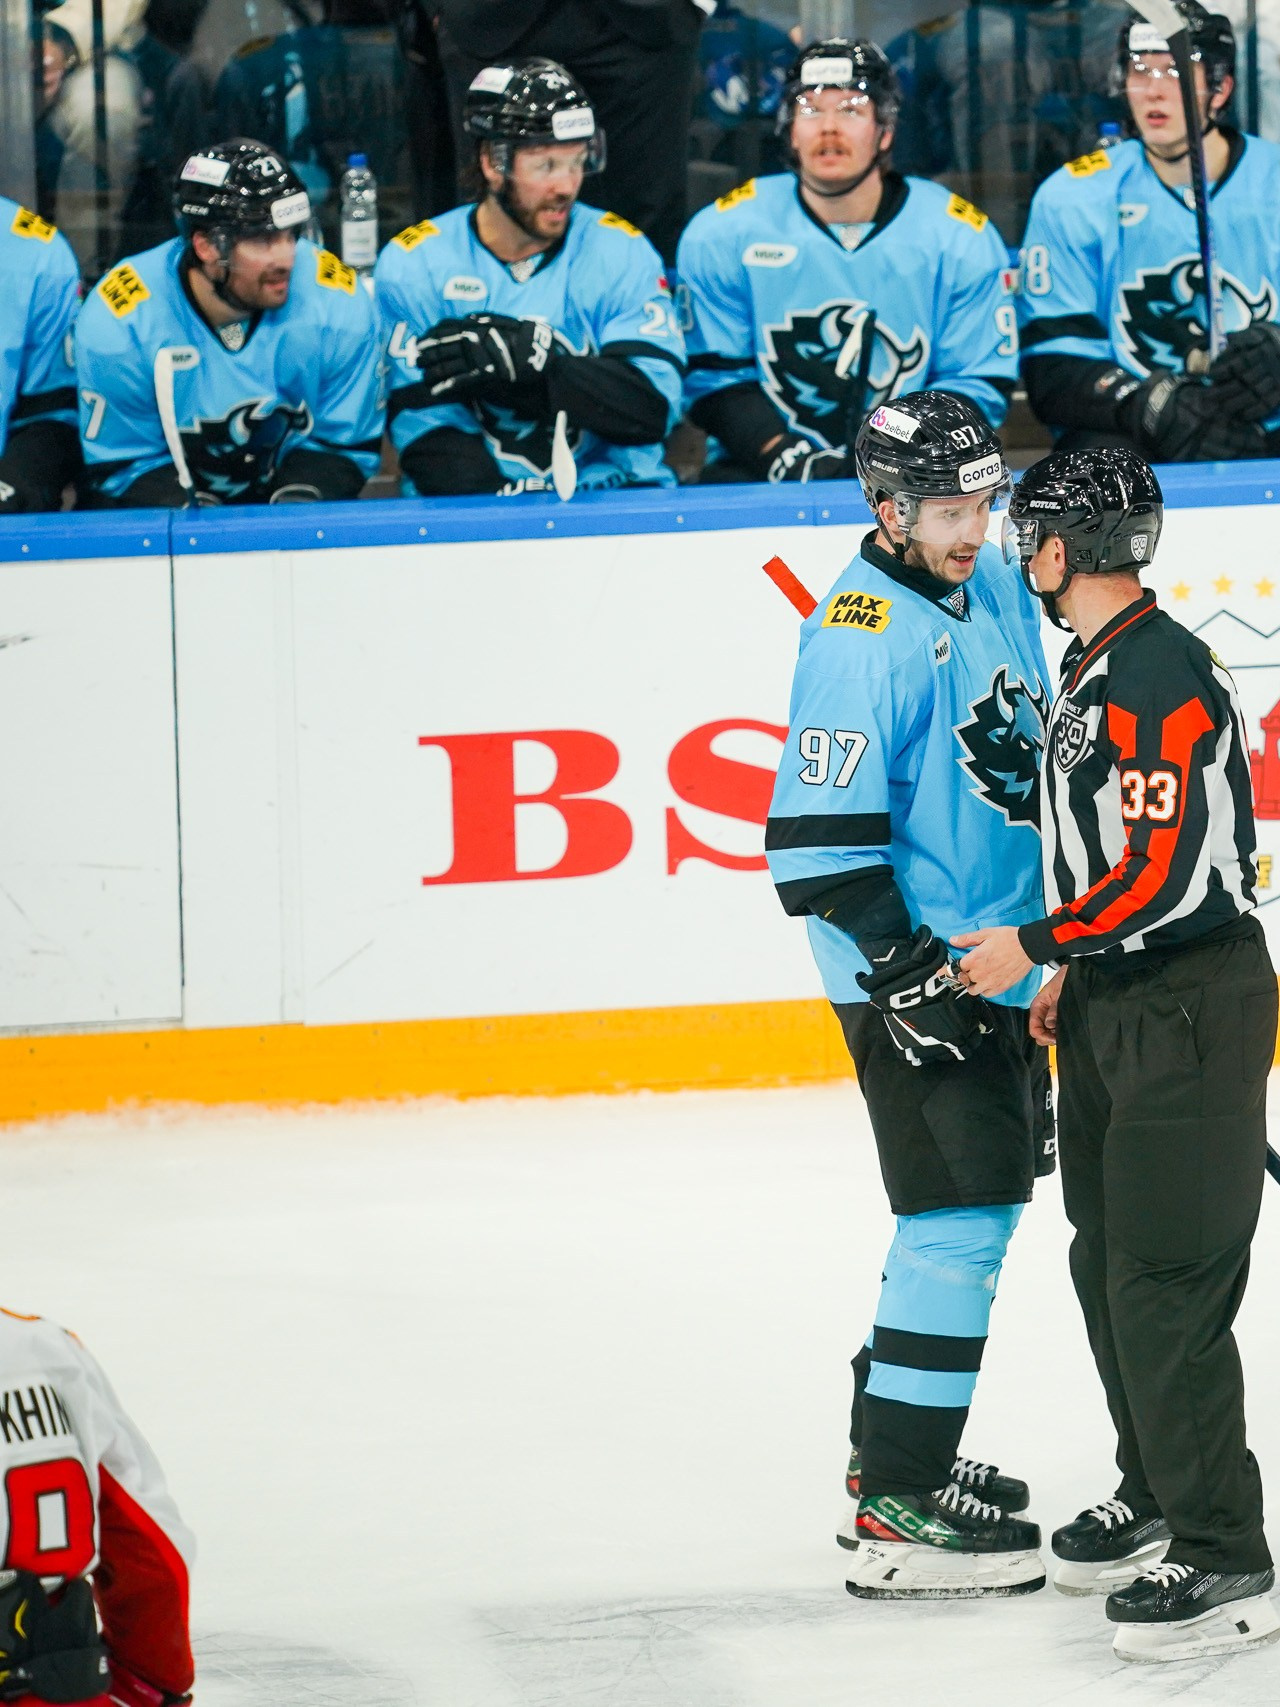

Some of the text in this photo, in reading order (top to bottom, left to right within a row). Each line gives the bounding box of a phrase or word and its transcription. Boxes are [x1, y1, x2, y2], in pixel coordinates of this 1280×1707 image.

[950, 425, 980, 450] 97
[830, 608, 883, 629] LINE
[833, 593, 884, 613] MAX
[798, 727, 869, 788] 97
[1121, 769, 1178, 821] 33
[876, 1495, 950, 1546] CCM
